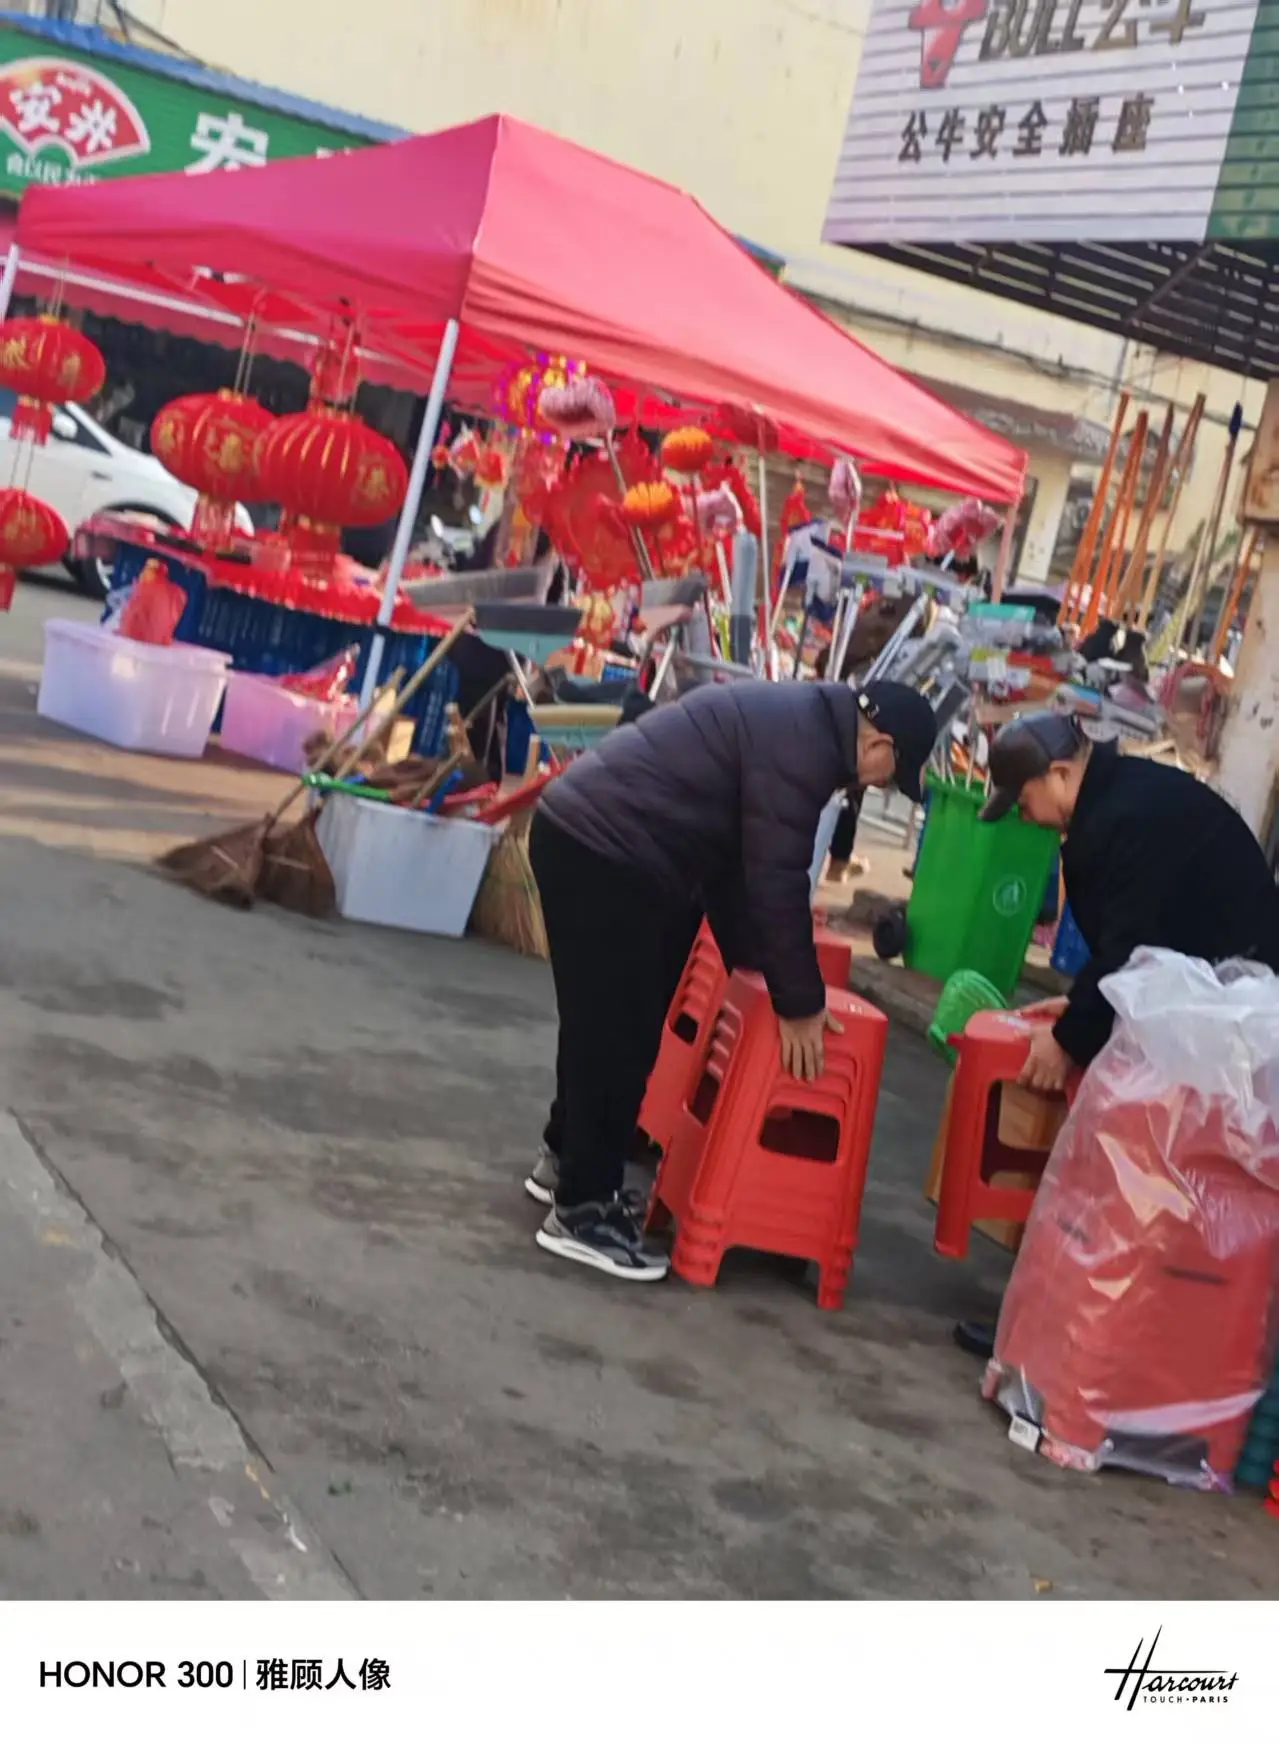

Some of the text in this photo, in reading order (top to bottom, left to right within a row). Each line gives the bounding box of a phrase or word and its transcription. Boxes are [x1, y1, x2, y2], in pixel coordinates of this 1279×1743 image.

[898, 91, 1155, 163] 公牛安全插座
